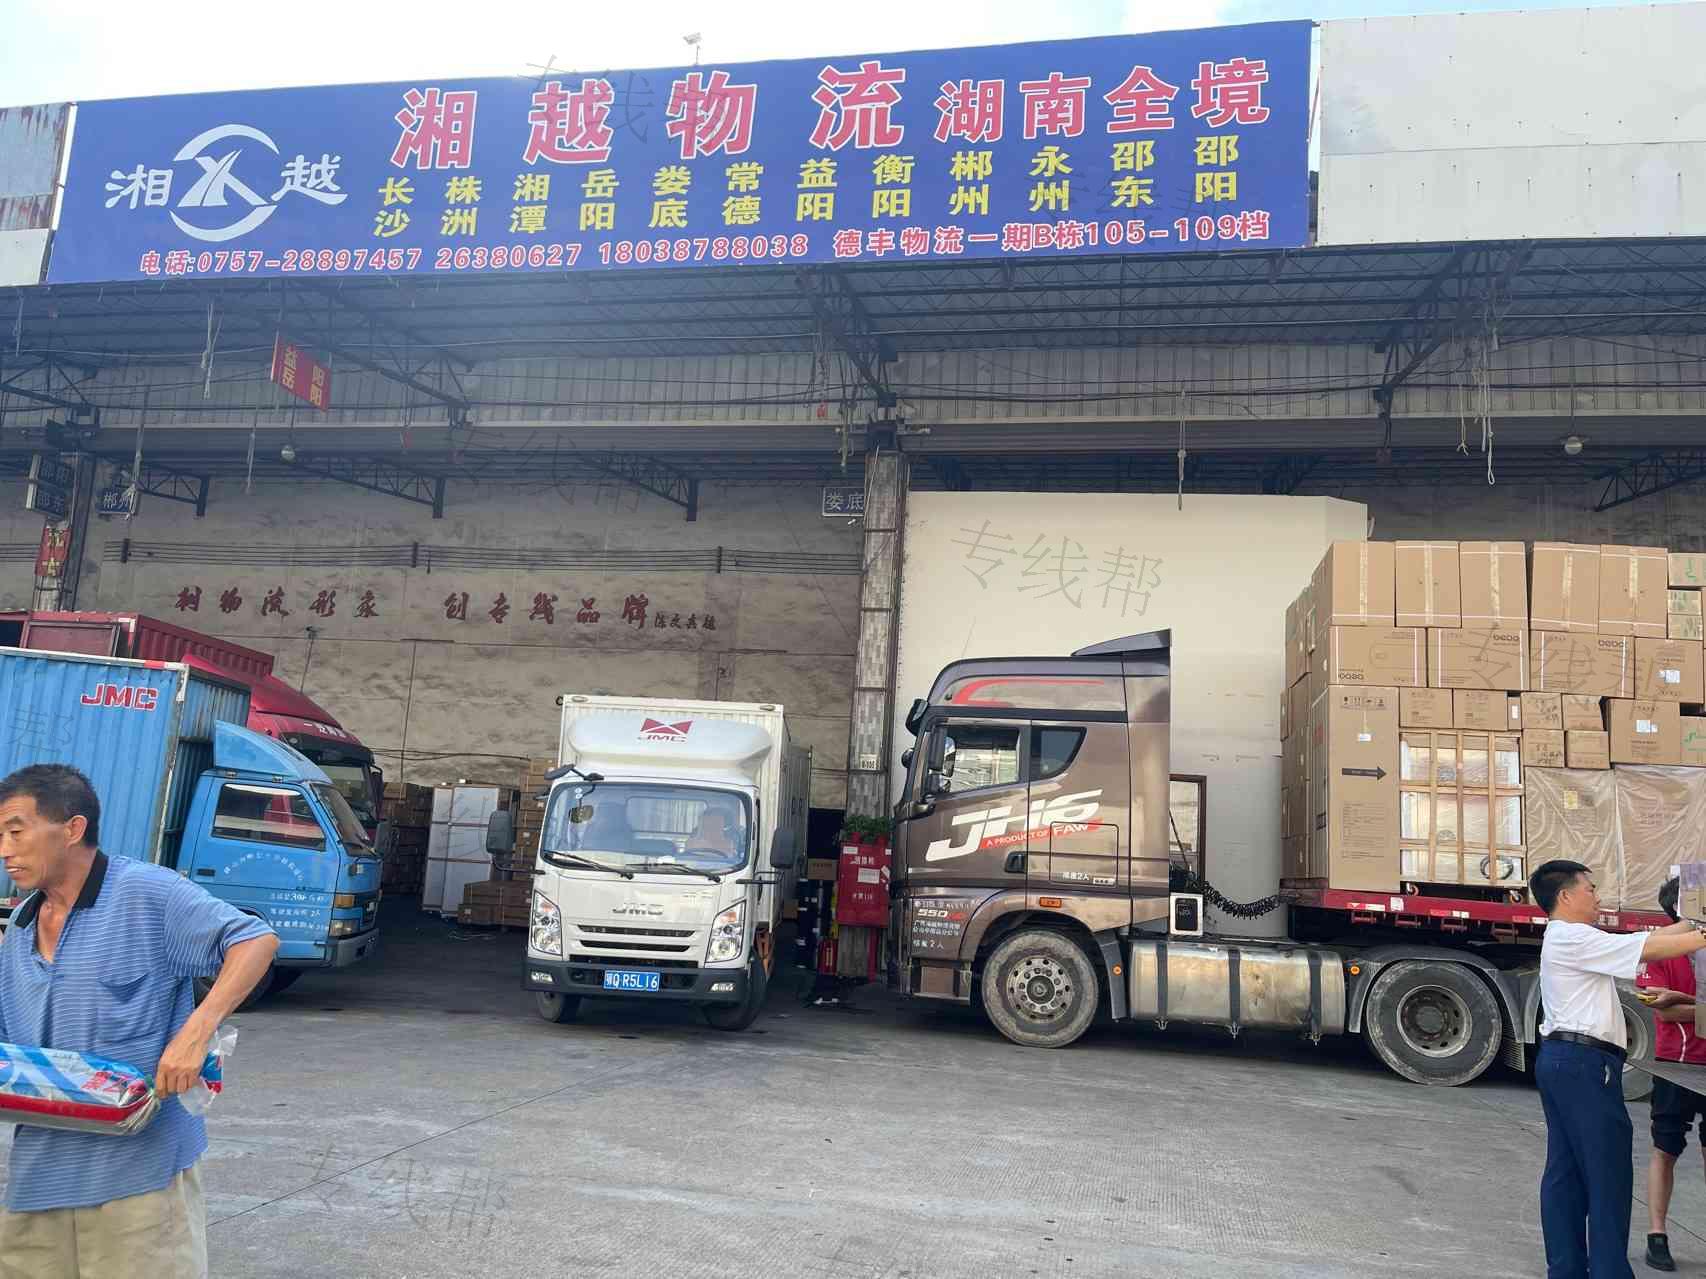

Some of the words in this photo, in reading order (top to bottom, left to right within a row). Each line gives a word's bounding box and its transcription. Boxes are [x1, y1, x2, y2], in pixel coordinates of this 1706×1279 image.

[391, 60, 906, 169] 湘越物流
[934, 57, 1270, 144] 湖南全境
[105, 163, 174, 209] 湘
[271, 154, 348, 206] 越
[649, 166, 691, 229] 娄底
[722, 162, 764, 226] 常德
[796, 158, 837, 222] 益阳
[872, 154, 915, 218] 衡阳
[949, 150, 993, 216] 郴州
[1029, 145, 1073, 212] 永州
[1110, 139, 1156, 208] 邵东
[1194, 134, 1240, 202] 邵阳
[373, 177, 415, 237] 长沙
[440, 175, 482, 236] 株洲
[510, 173, 550, 234] 湘潭
[579, 169, 619, 231] 岳阳
[436, 244, 583, 269] 26380627
[599, 234, 809, 265] 18038788038
[832, 211, 1271, 257] 德丰物流一期B栋105-109档
[825, 492, 865, 512] 娄底
[81, 683, 159, 711] JMC
[638, 734, 687, 743] JMC
[994, 831, 1034, 846] PRODUCT
[1036, 829, 1049, 839] OF
[1053, 822, 1090, 836] FAW
